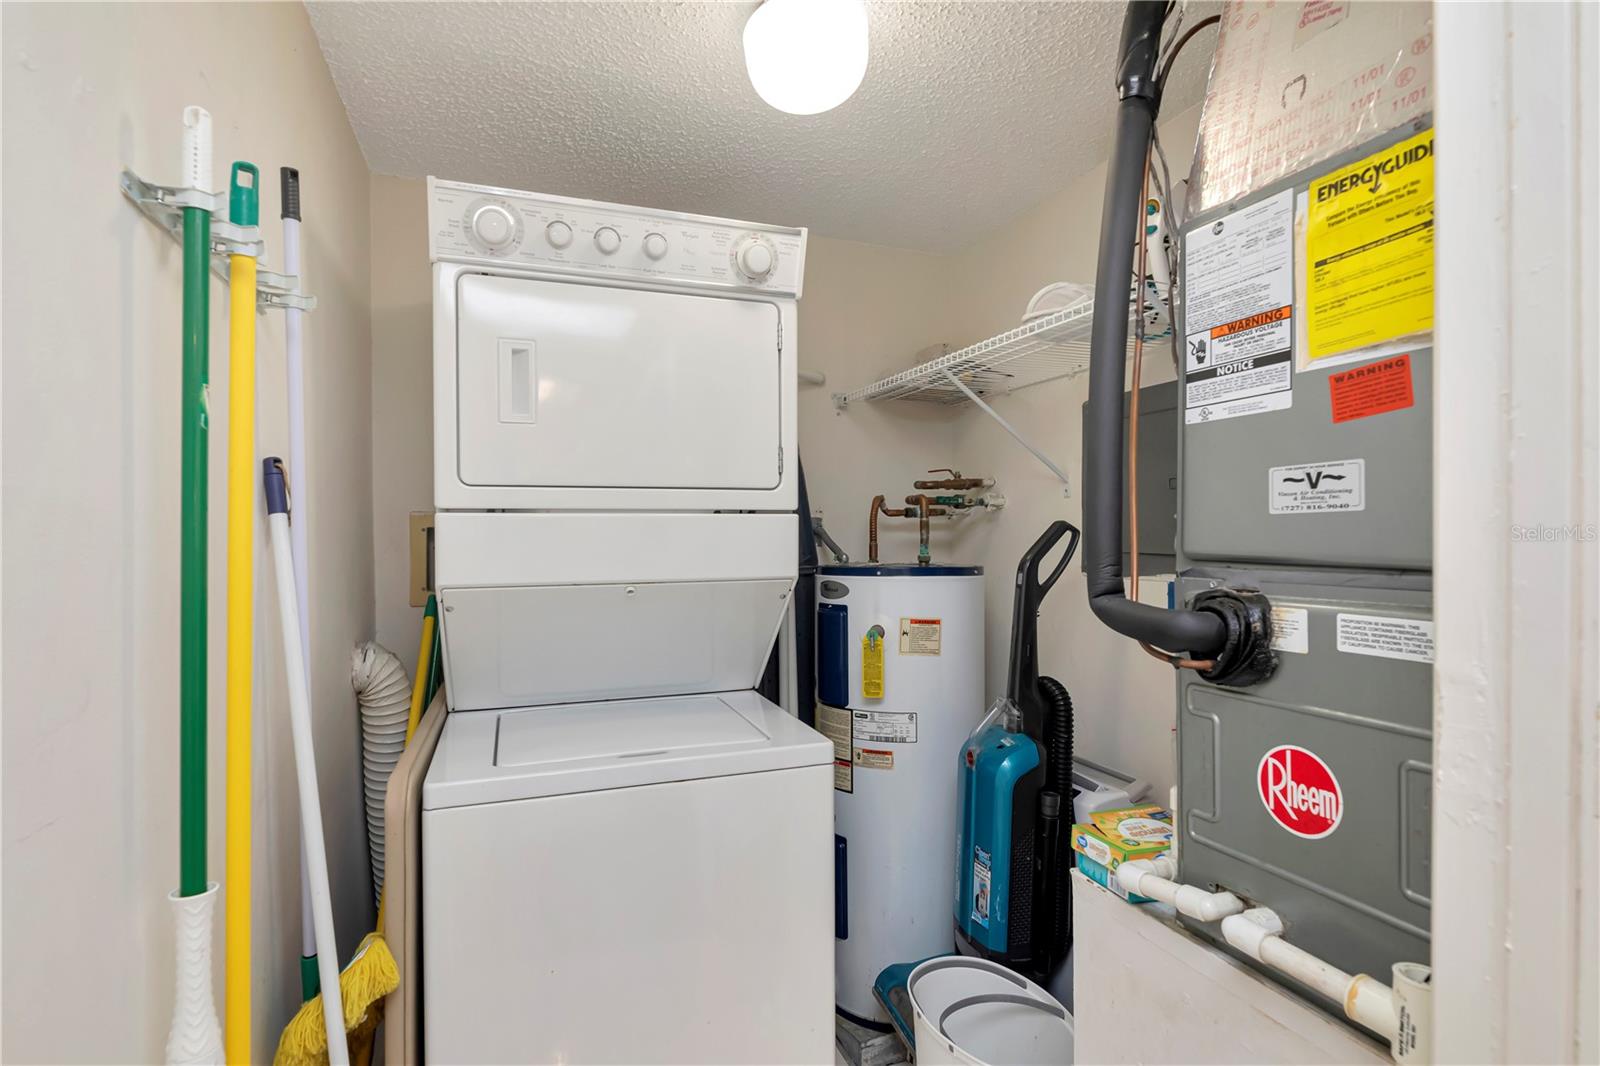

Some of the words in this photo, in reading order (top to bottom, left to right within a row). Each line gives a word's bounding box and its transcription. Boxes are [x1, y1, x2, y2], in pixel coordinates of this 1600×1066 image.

[1353, 64, 1386, 88] 11/01
[1227, 309, 1283, 334] WARNING
[1218, 328, 1254, 344] HAZARDOUS
[1255, 321, 1283, 334] VOLTAGE
[1216, 360, 1254, 376] NOTICE
[1334, 359, 1405, 383] WARNING
[1305, 471, 1323, 490] V
[1340, 624, 1367, 632] APPLIANCE
[1368, 626, 1393, 634] CONTAINS
[1394, 628, 1428, 638] FIBERGLASS
[1348, 641, 1377, 650] CALIFORNIA
[1382, 639, 1402, 647] KNOWN
[1268, 749, 1336, 821] Rheem
